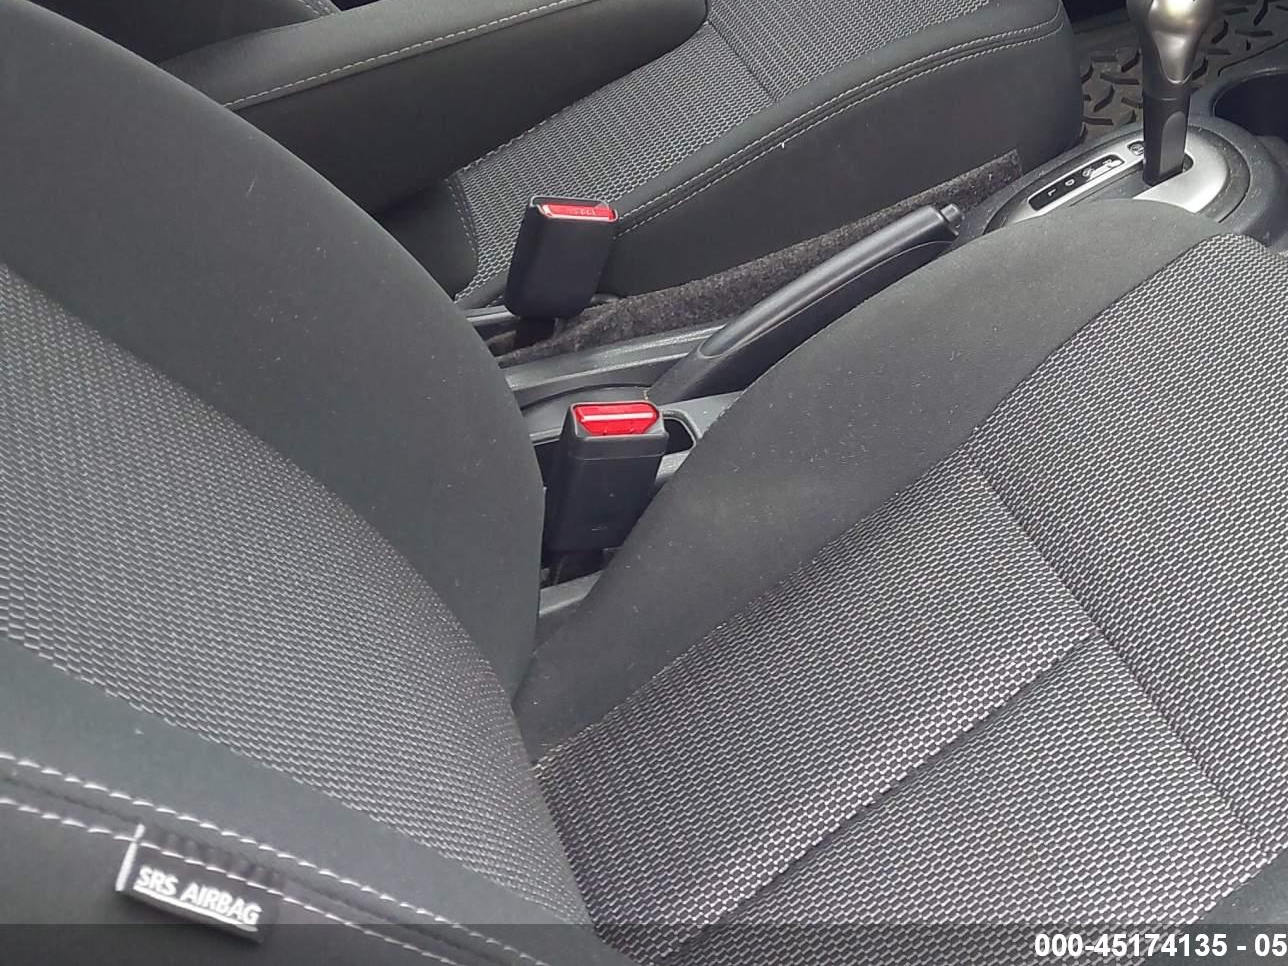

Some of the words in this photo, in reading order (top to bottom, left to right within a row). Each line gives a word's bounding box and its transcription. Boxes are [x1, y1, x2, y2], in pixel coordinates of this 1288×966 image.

[1064, 178, 1075, 187] D
[1047, 188, 1057, 197] L
[134, 866, 179, 897] SRS
[180, 882, 263, 925] AIRBAG
